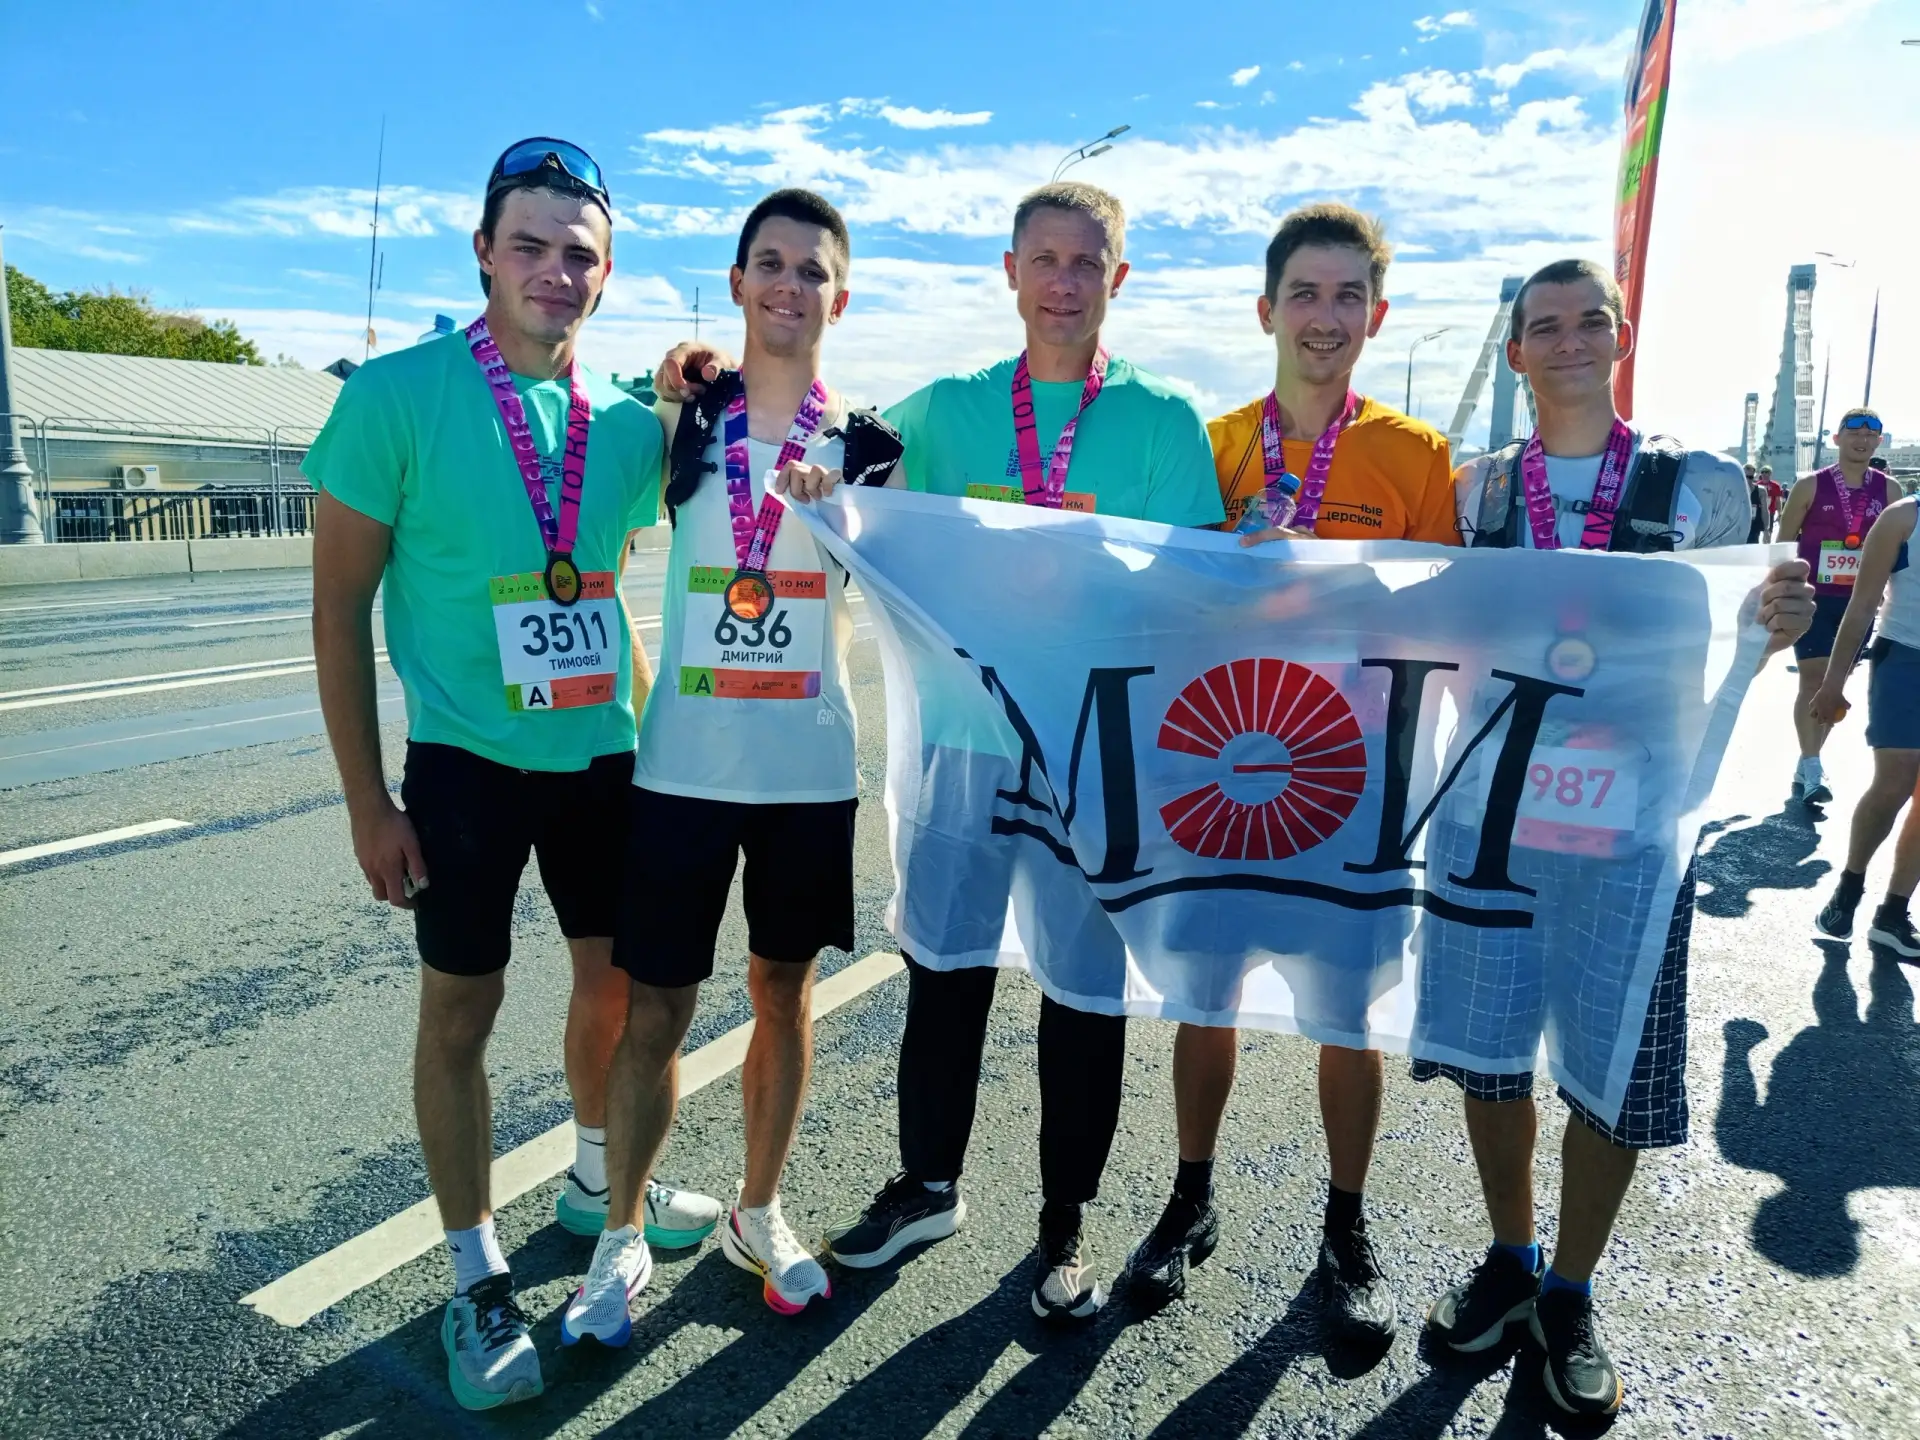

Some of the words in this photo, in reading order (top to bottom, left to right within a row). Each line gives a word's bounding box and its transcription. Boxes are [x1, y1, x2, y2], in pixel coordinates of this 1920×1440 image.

[520, 611, 608, 657] 3511
[714, 607, 792, 649] 636
[549, 652, 602, 671] ТИМОФЕЙ
[721, 650, 783, 664] ДМИТРИЙ
